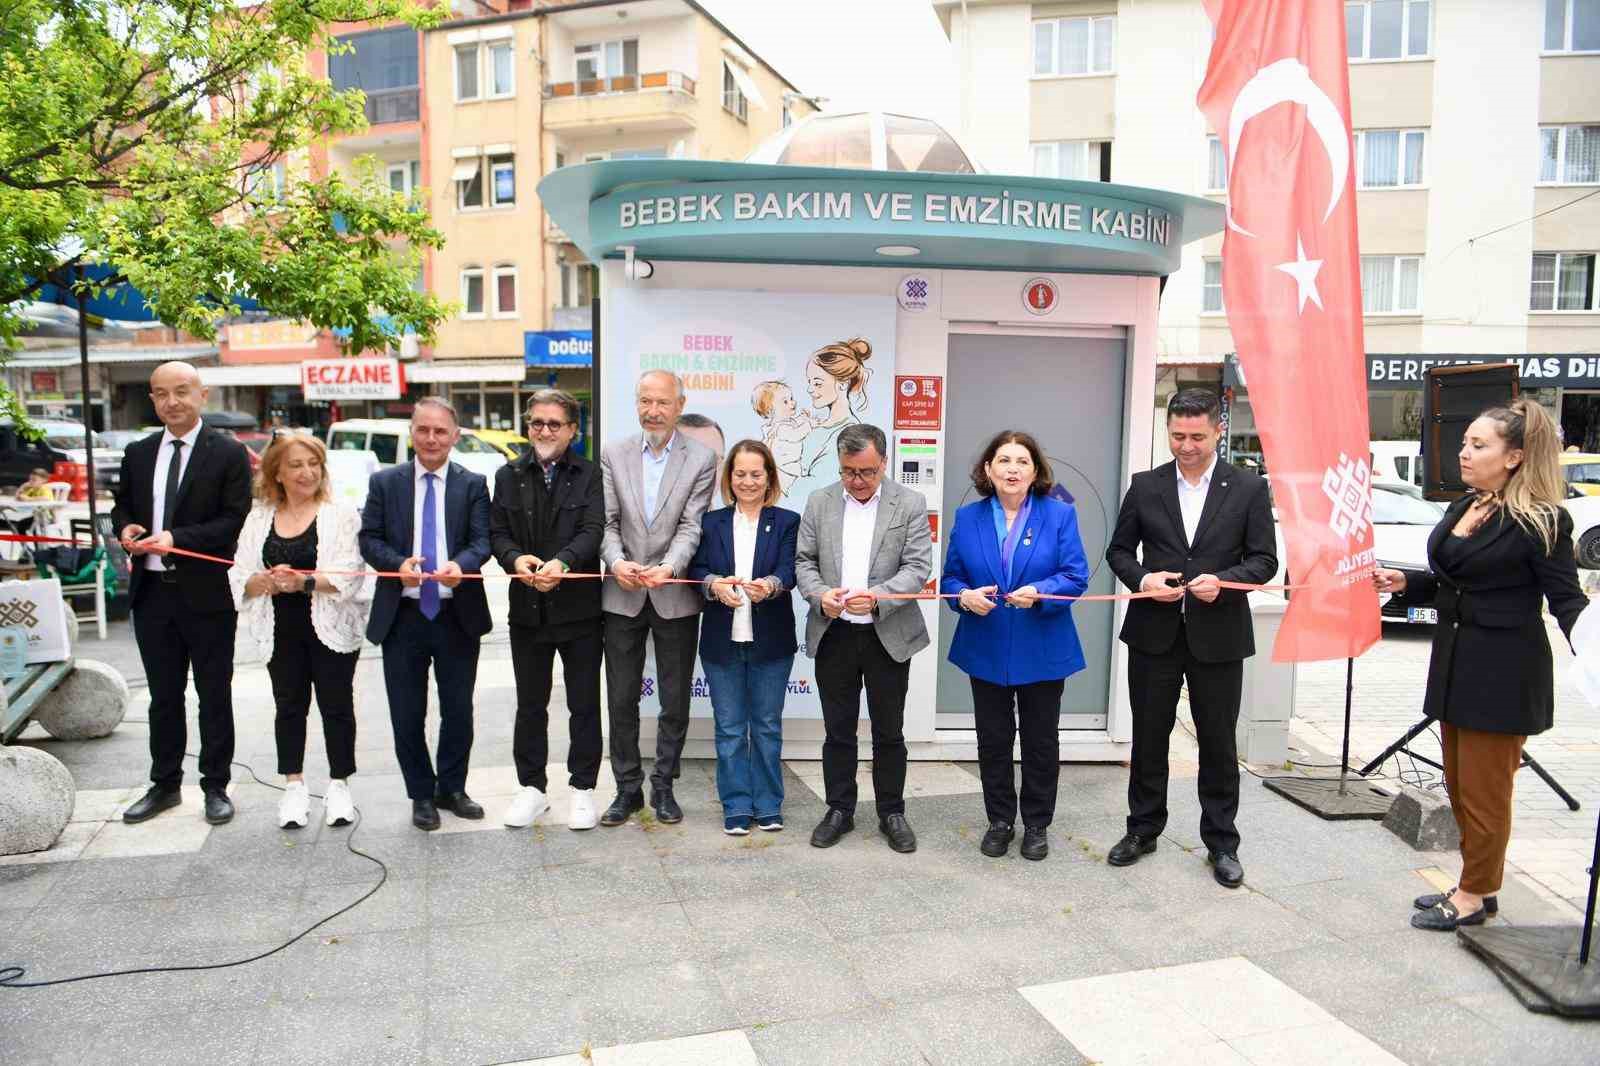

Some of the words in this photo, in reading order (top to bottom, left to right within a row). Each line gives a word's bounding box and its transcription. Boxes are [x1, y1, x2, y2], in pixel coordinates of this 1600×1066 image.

[620, 193, 723, 228] BEBEK
[733, 191, 852, 221] BAKIM
[863, 192, 913, 222] VE
[924, 190, 1082, 231] EMZİRME
[1090, 207, 1170, 246] KABİNİ
[683, 335, 734, 351] BEBEK
[690, 353, 705, 371] &
[708, 352, 777, 371] EMZİRME
[307, 364, 392, 384] ECZANE
[1415, 609, 1425, 620] 35
